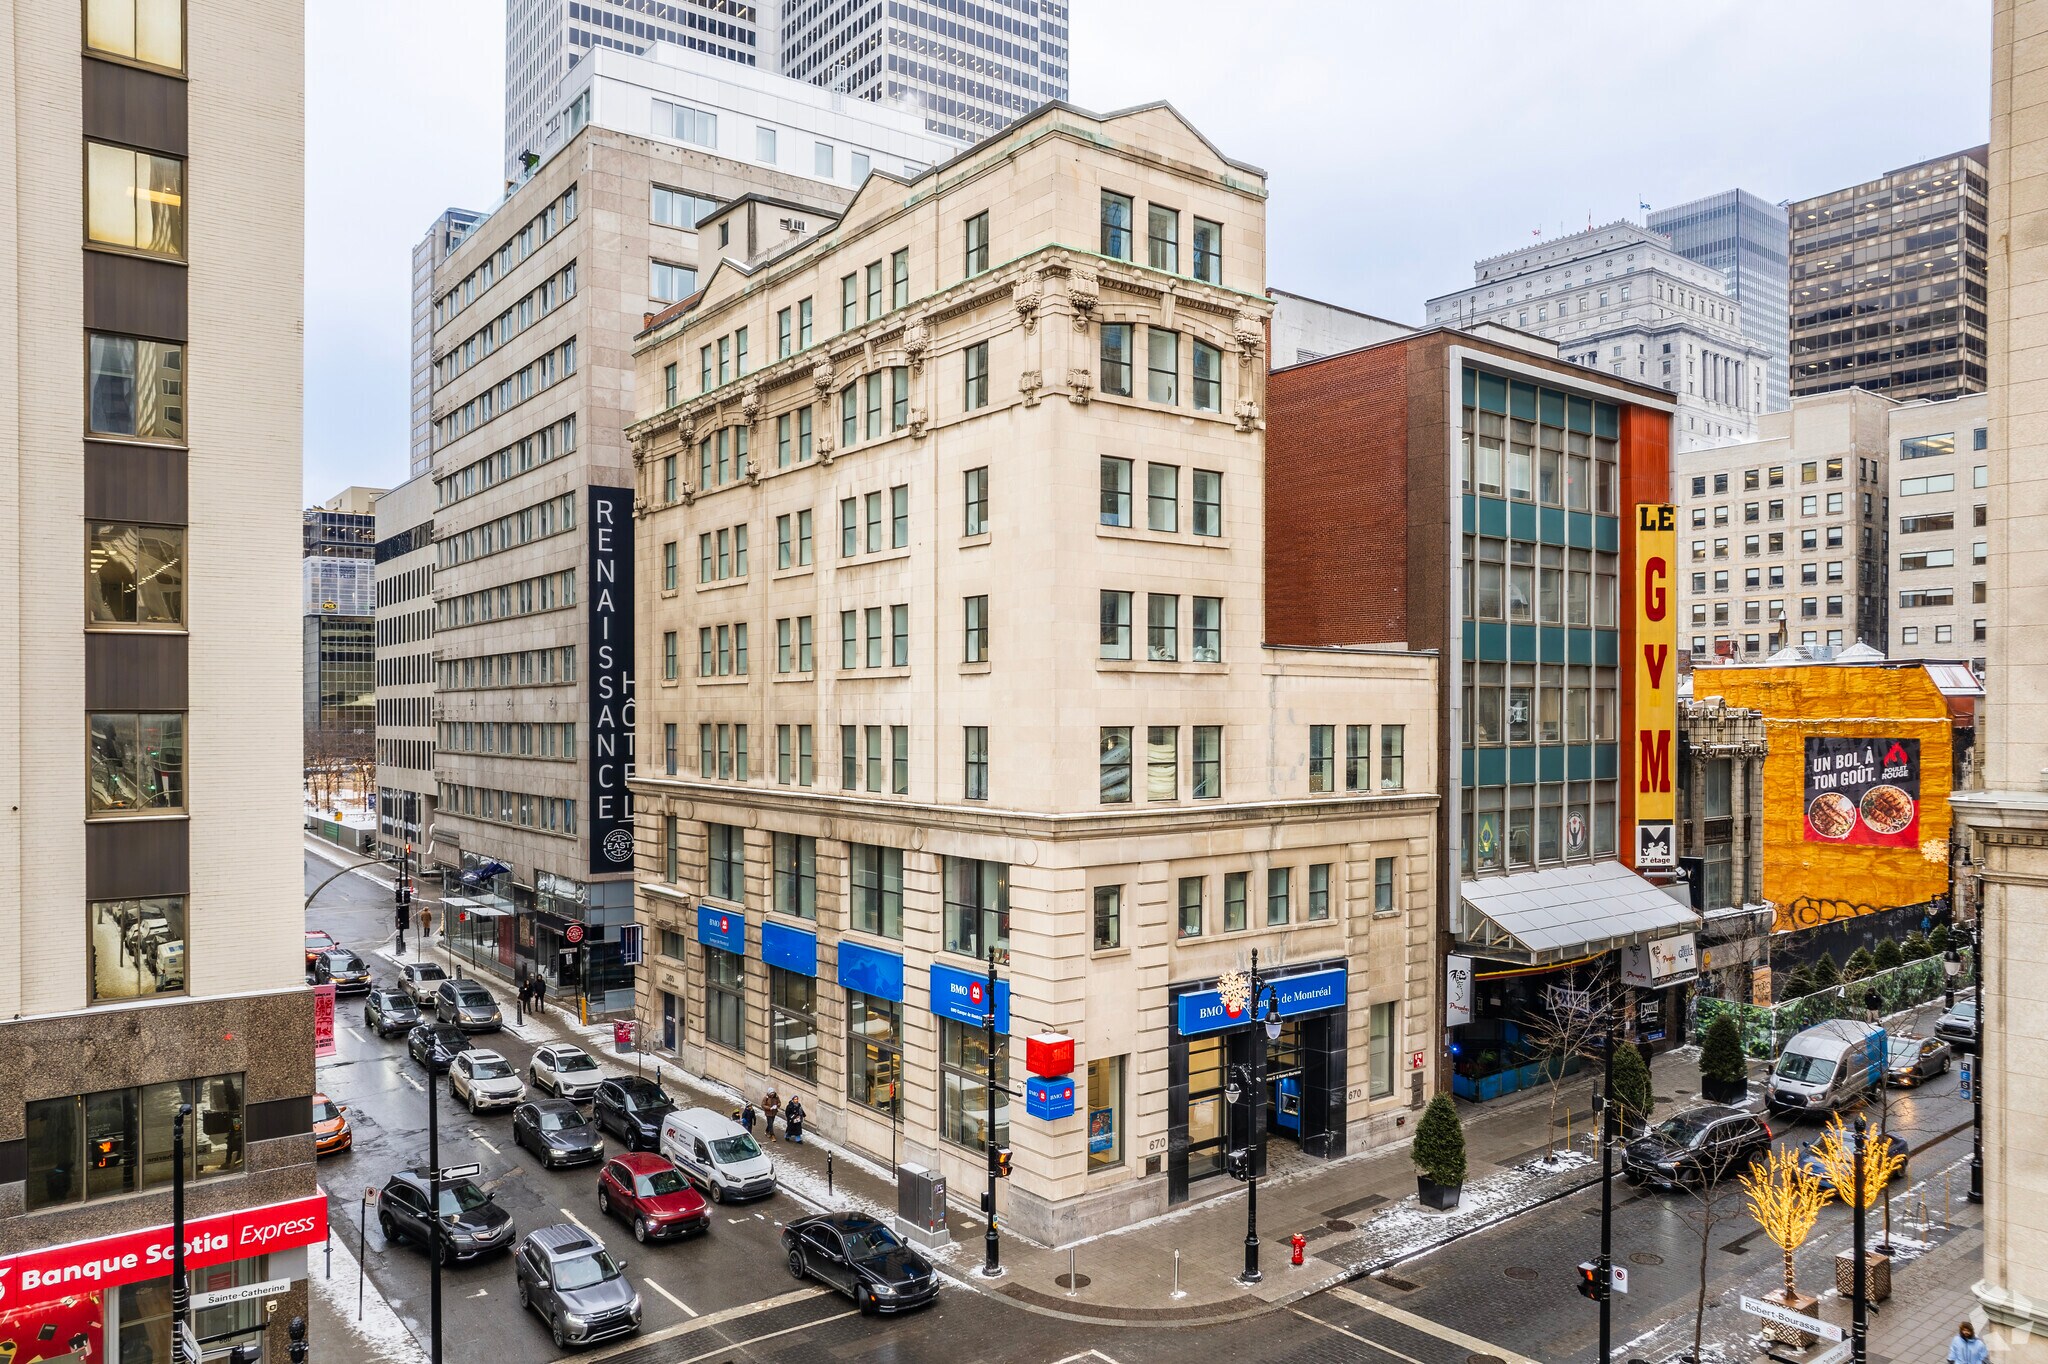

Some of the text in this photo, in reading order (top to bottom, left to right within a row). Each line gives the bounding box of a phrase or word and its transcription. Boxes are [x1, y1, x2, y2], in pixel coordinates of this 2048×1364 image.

[1640, 507, 1674, 531] LE
[596, 500, 615, 819] RENAISSANCE
[1640, 557, 1671, 793] GYM
[1813, 746, 1874, 772] UN BOL À
[1884, 764, 1907, 773] POULET
[1813, 765, 1876, 790] TON GOÛT.
[1881, 769, 1909, 780] ROUGE
[607, 842, 631, 850] EAST
[950, 983, 968, 996] BMO
[1199, 1005, 1223, 1019] BMO
[1281, 993, 1292, 1004] de
[1293, 985, 1332, 1001] Montréal
[1348, 1089, 1361, 1100] 670
[1149, 1137, 1166, 1151] 670
[239, 1215, 316, 1246] Express
[22, 1254, 138, 1291] Banque
[208, 1285, 285, 1304] Sainte-Catherine
[1745, 1301, 1821, 1333] Robert-Bourassa
